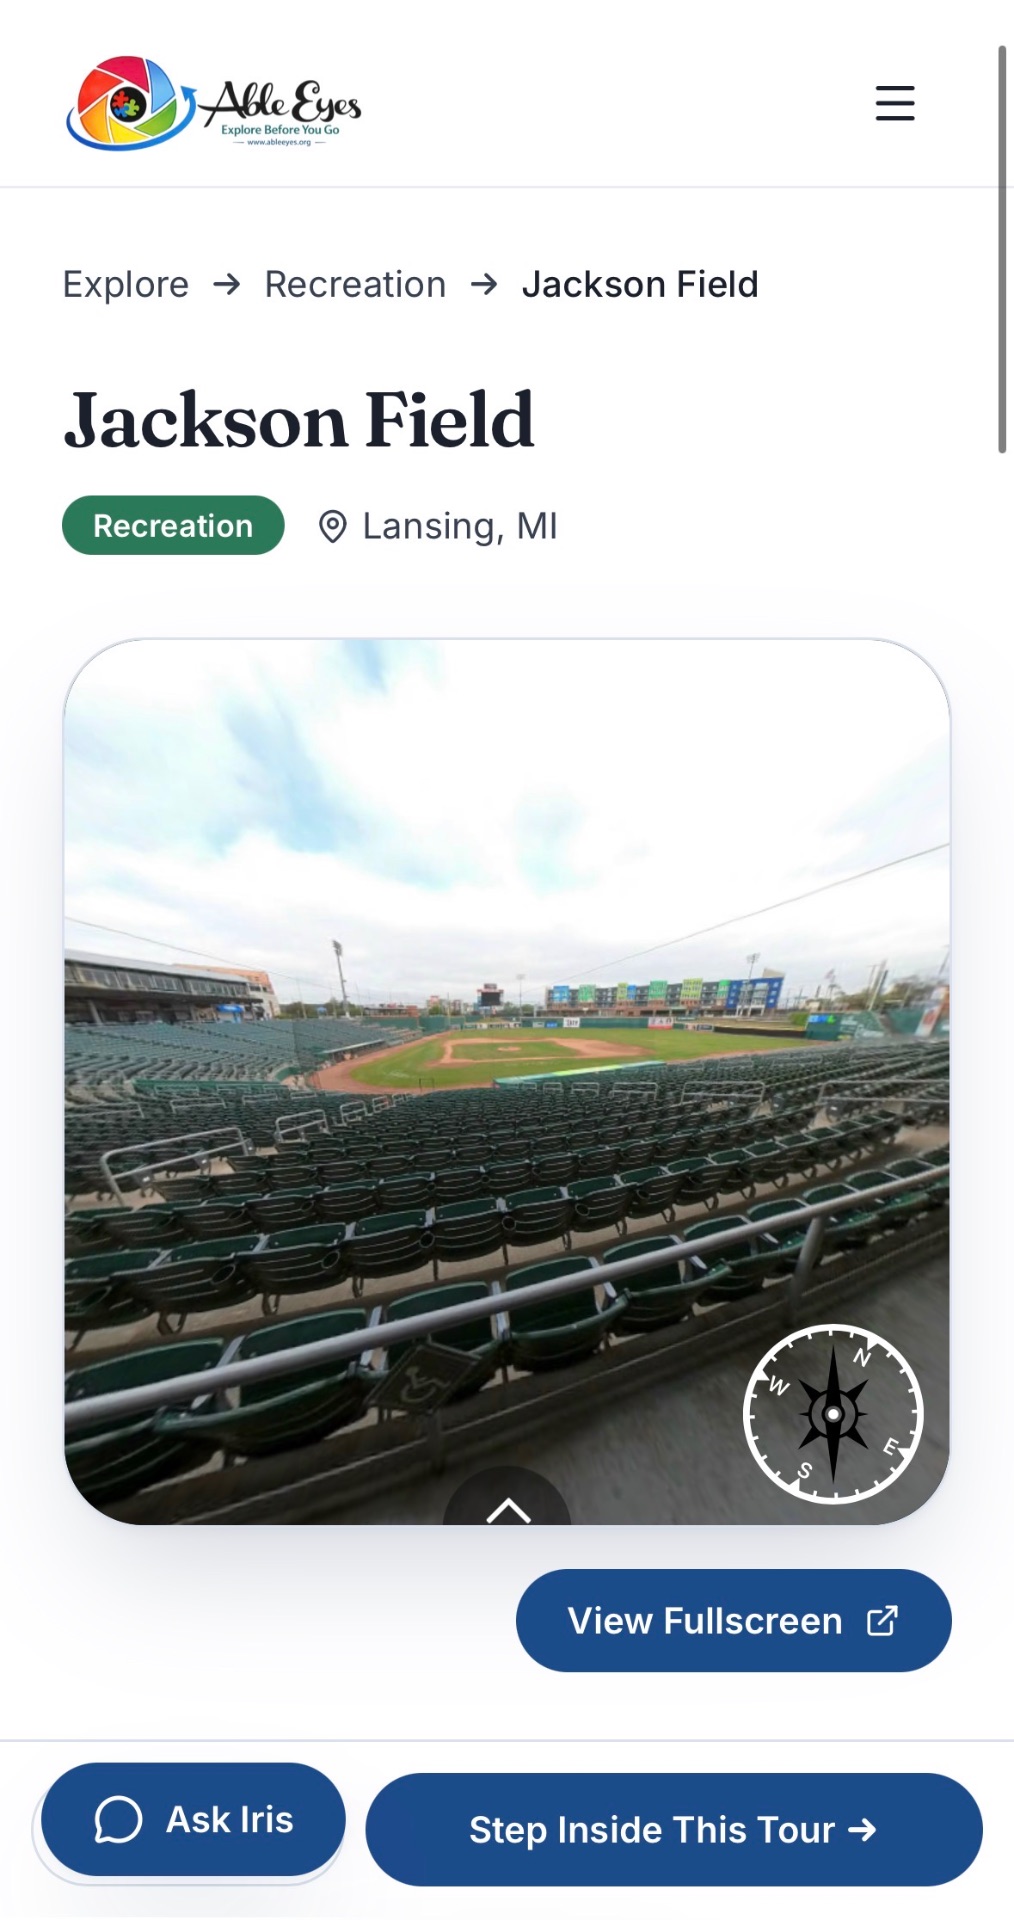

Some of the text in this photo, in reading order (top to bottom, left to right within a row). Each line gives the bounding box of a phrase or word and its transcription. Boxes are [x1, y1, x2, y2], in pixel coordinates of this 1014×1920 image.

[197, 79, 362, 128] Able Eyes
[221, 124, 340, 137] Explore Before You Go
[247, 138, 312, 147] www.ableeyes.org
[63, 270, 189, 305] Explore
[265, 269, 446, 298] Recreation
[522, 269, 758, 298] Jackson Field
[63, 388, 536, 449] Jackson Field
[94, 512, 253, 538] Recreation
[364, 510, 558, 547] Lansing, MI
[853, 1348, 872, 1368] N
[769, 1375, 791, 1396] W
[882, 1437, 899, 1456] E
[797, 1462, 813, 1479] S
[567, 1605, 842, 1635] View Fullscreen
[165, 1804, 294, 1834] Ask Iris
[469, 1814, 836, 1851] Step Inside This Tour
